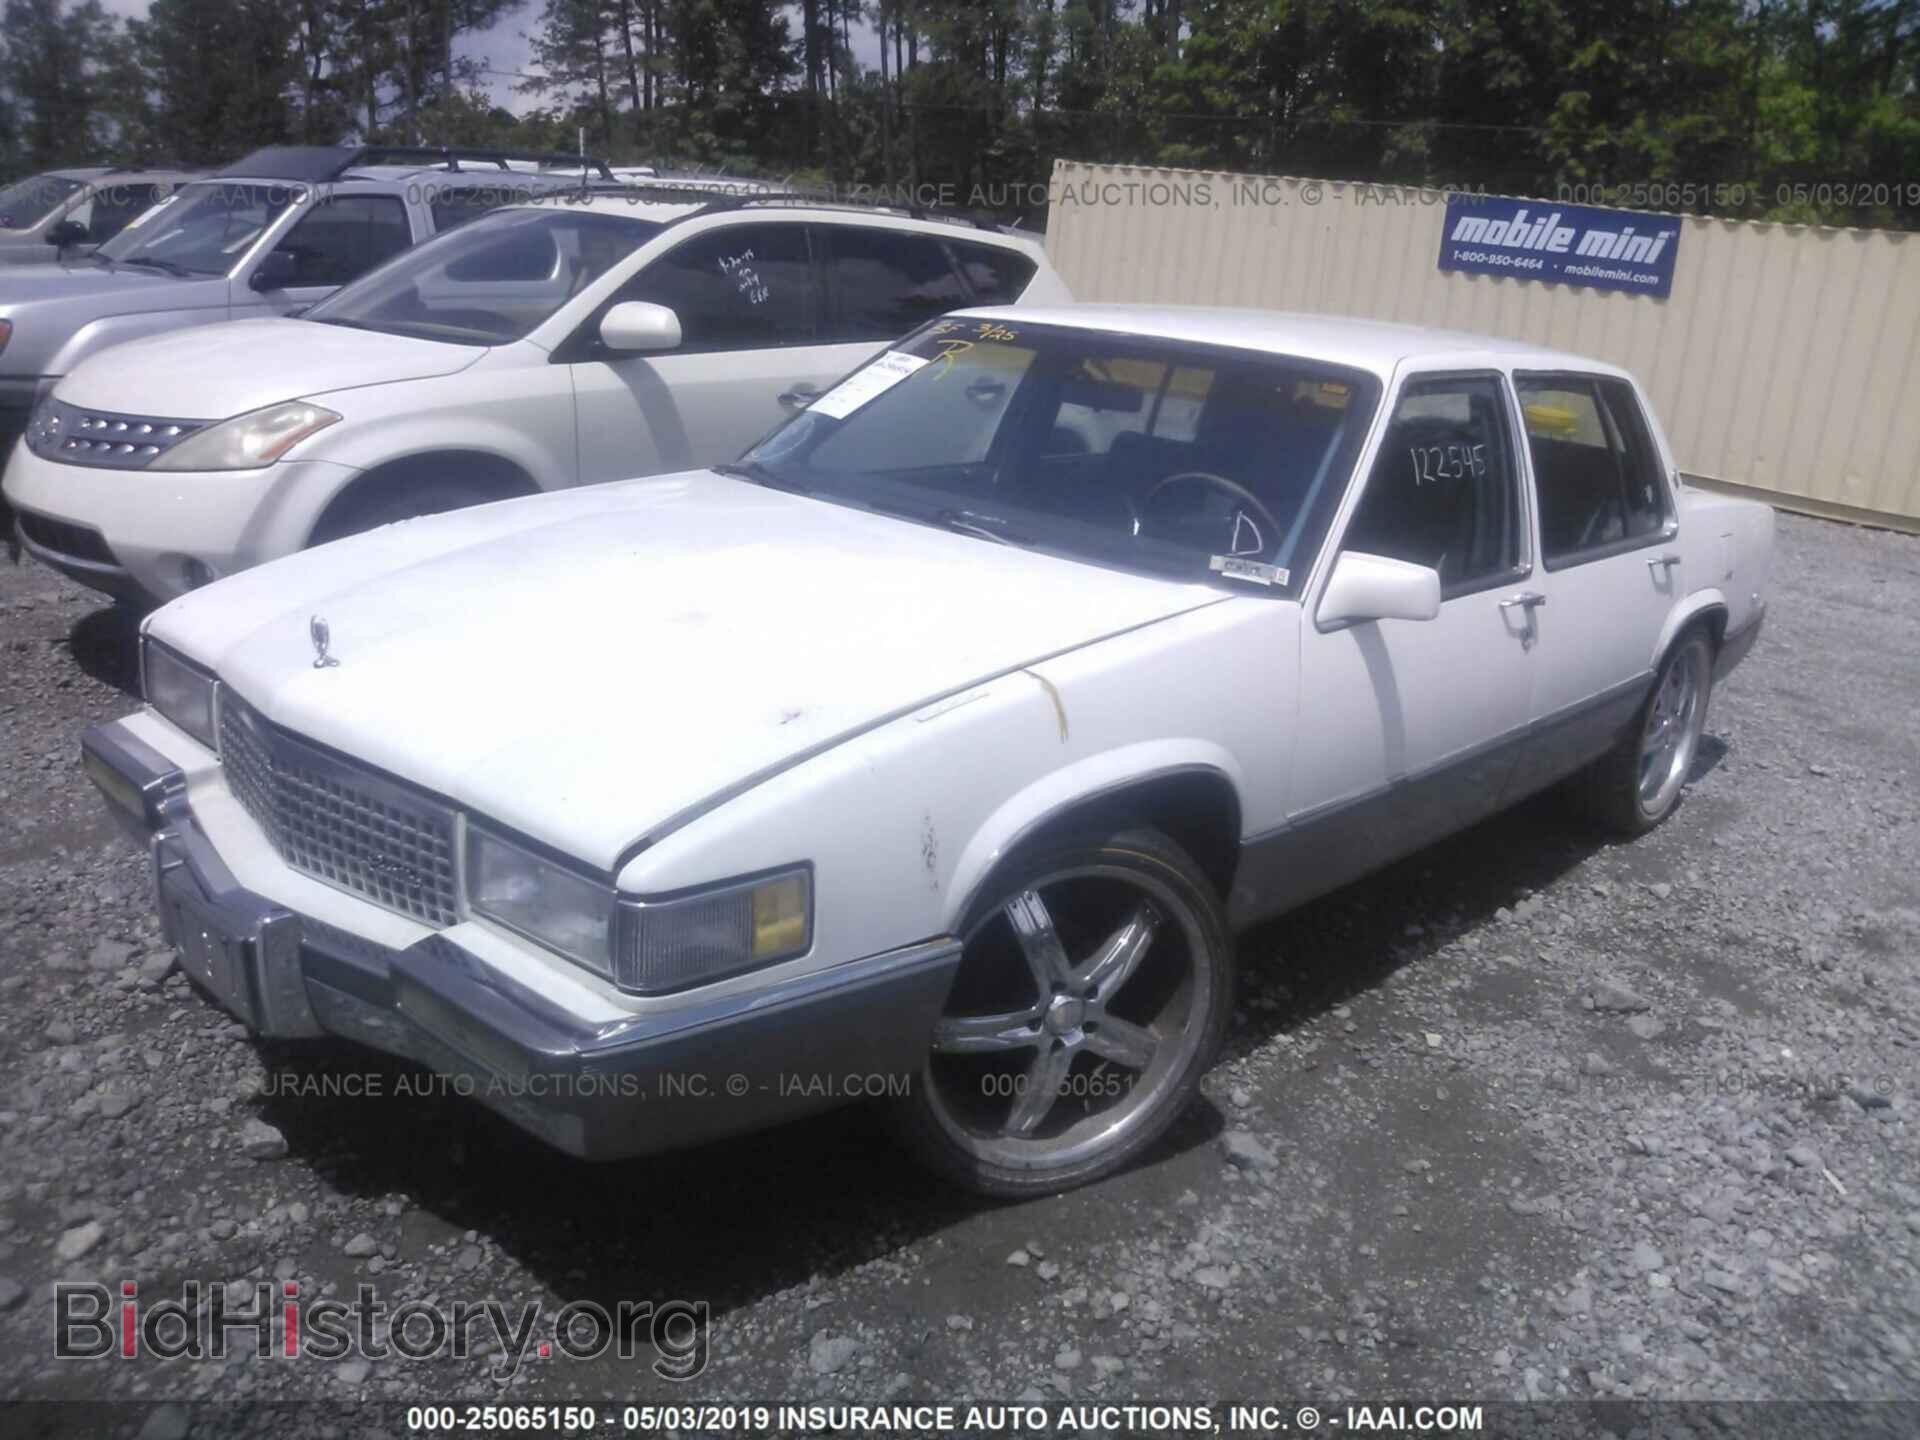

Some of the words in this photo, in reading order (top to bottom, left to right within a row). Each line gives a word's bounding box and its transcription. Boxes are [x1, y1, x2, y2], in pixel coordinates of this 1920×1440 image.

[1451, 209, 1576, 253] mobile
[1576, 227, 1671, 264] mini
[1564, 264, 1659, 284] mobilemini.com
[1409, 444, 1486, 486] 122545
